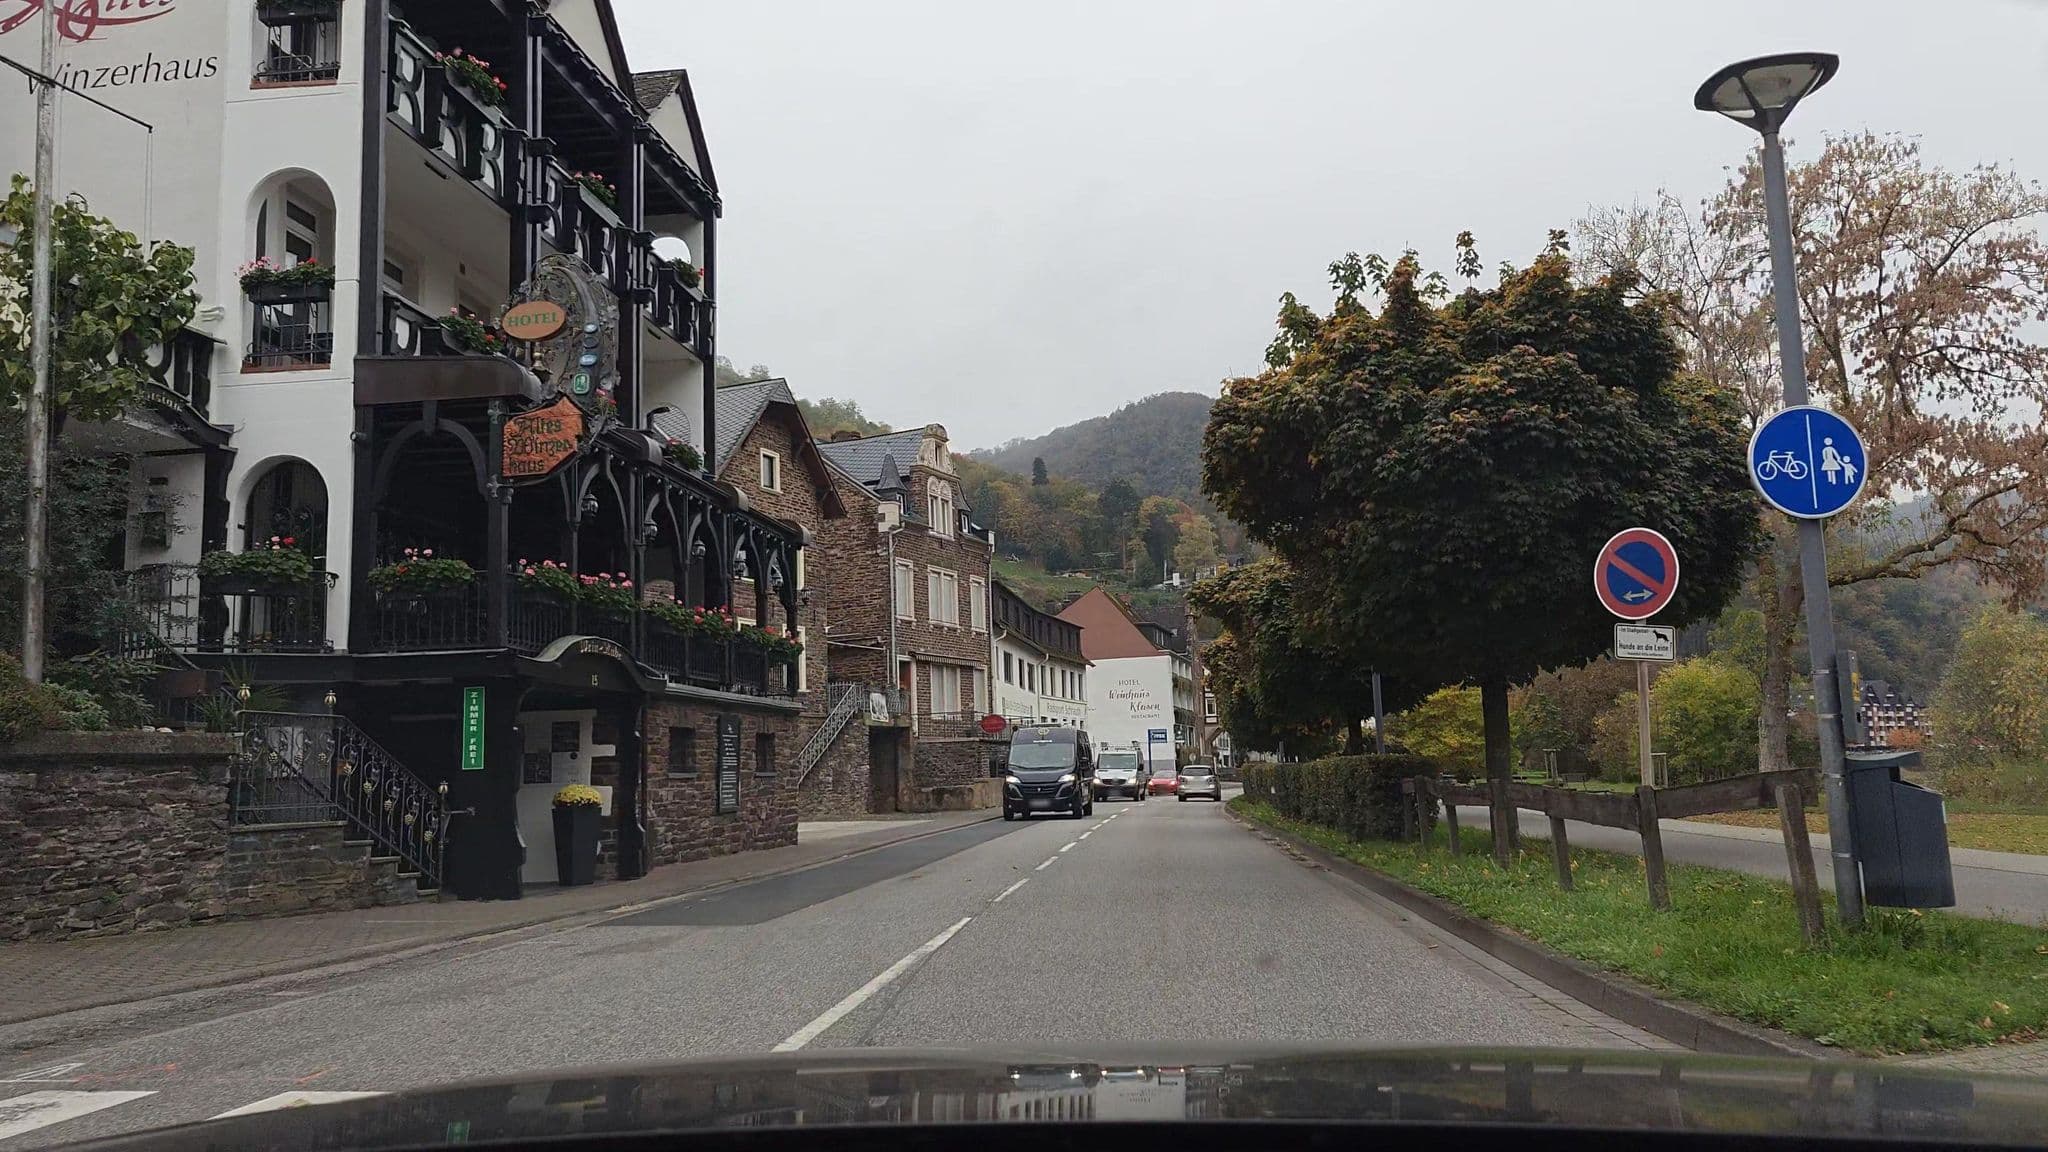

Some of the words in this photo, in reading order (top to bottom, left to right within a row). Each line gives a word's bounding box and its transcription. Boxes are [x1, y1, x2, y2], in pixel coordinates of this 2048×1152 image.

[509, 312, 559, 328] HOTEL
[510, 457, 545, 473] haus
[469, 691, 479, 732] ZIMMER
[468, 737, 478, 765] FREI
